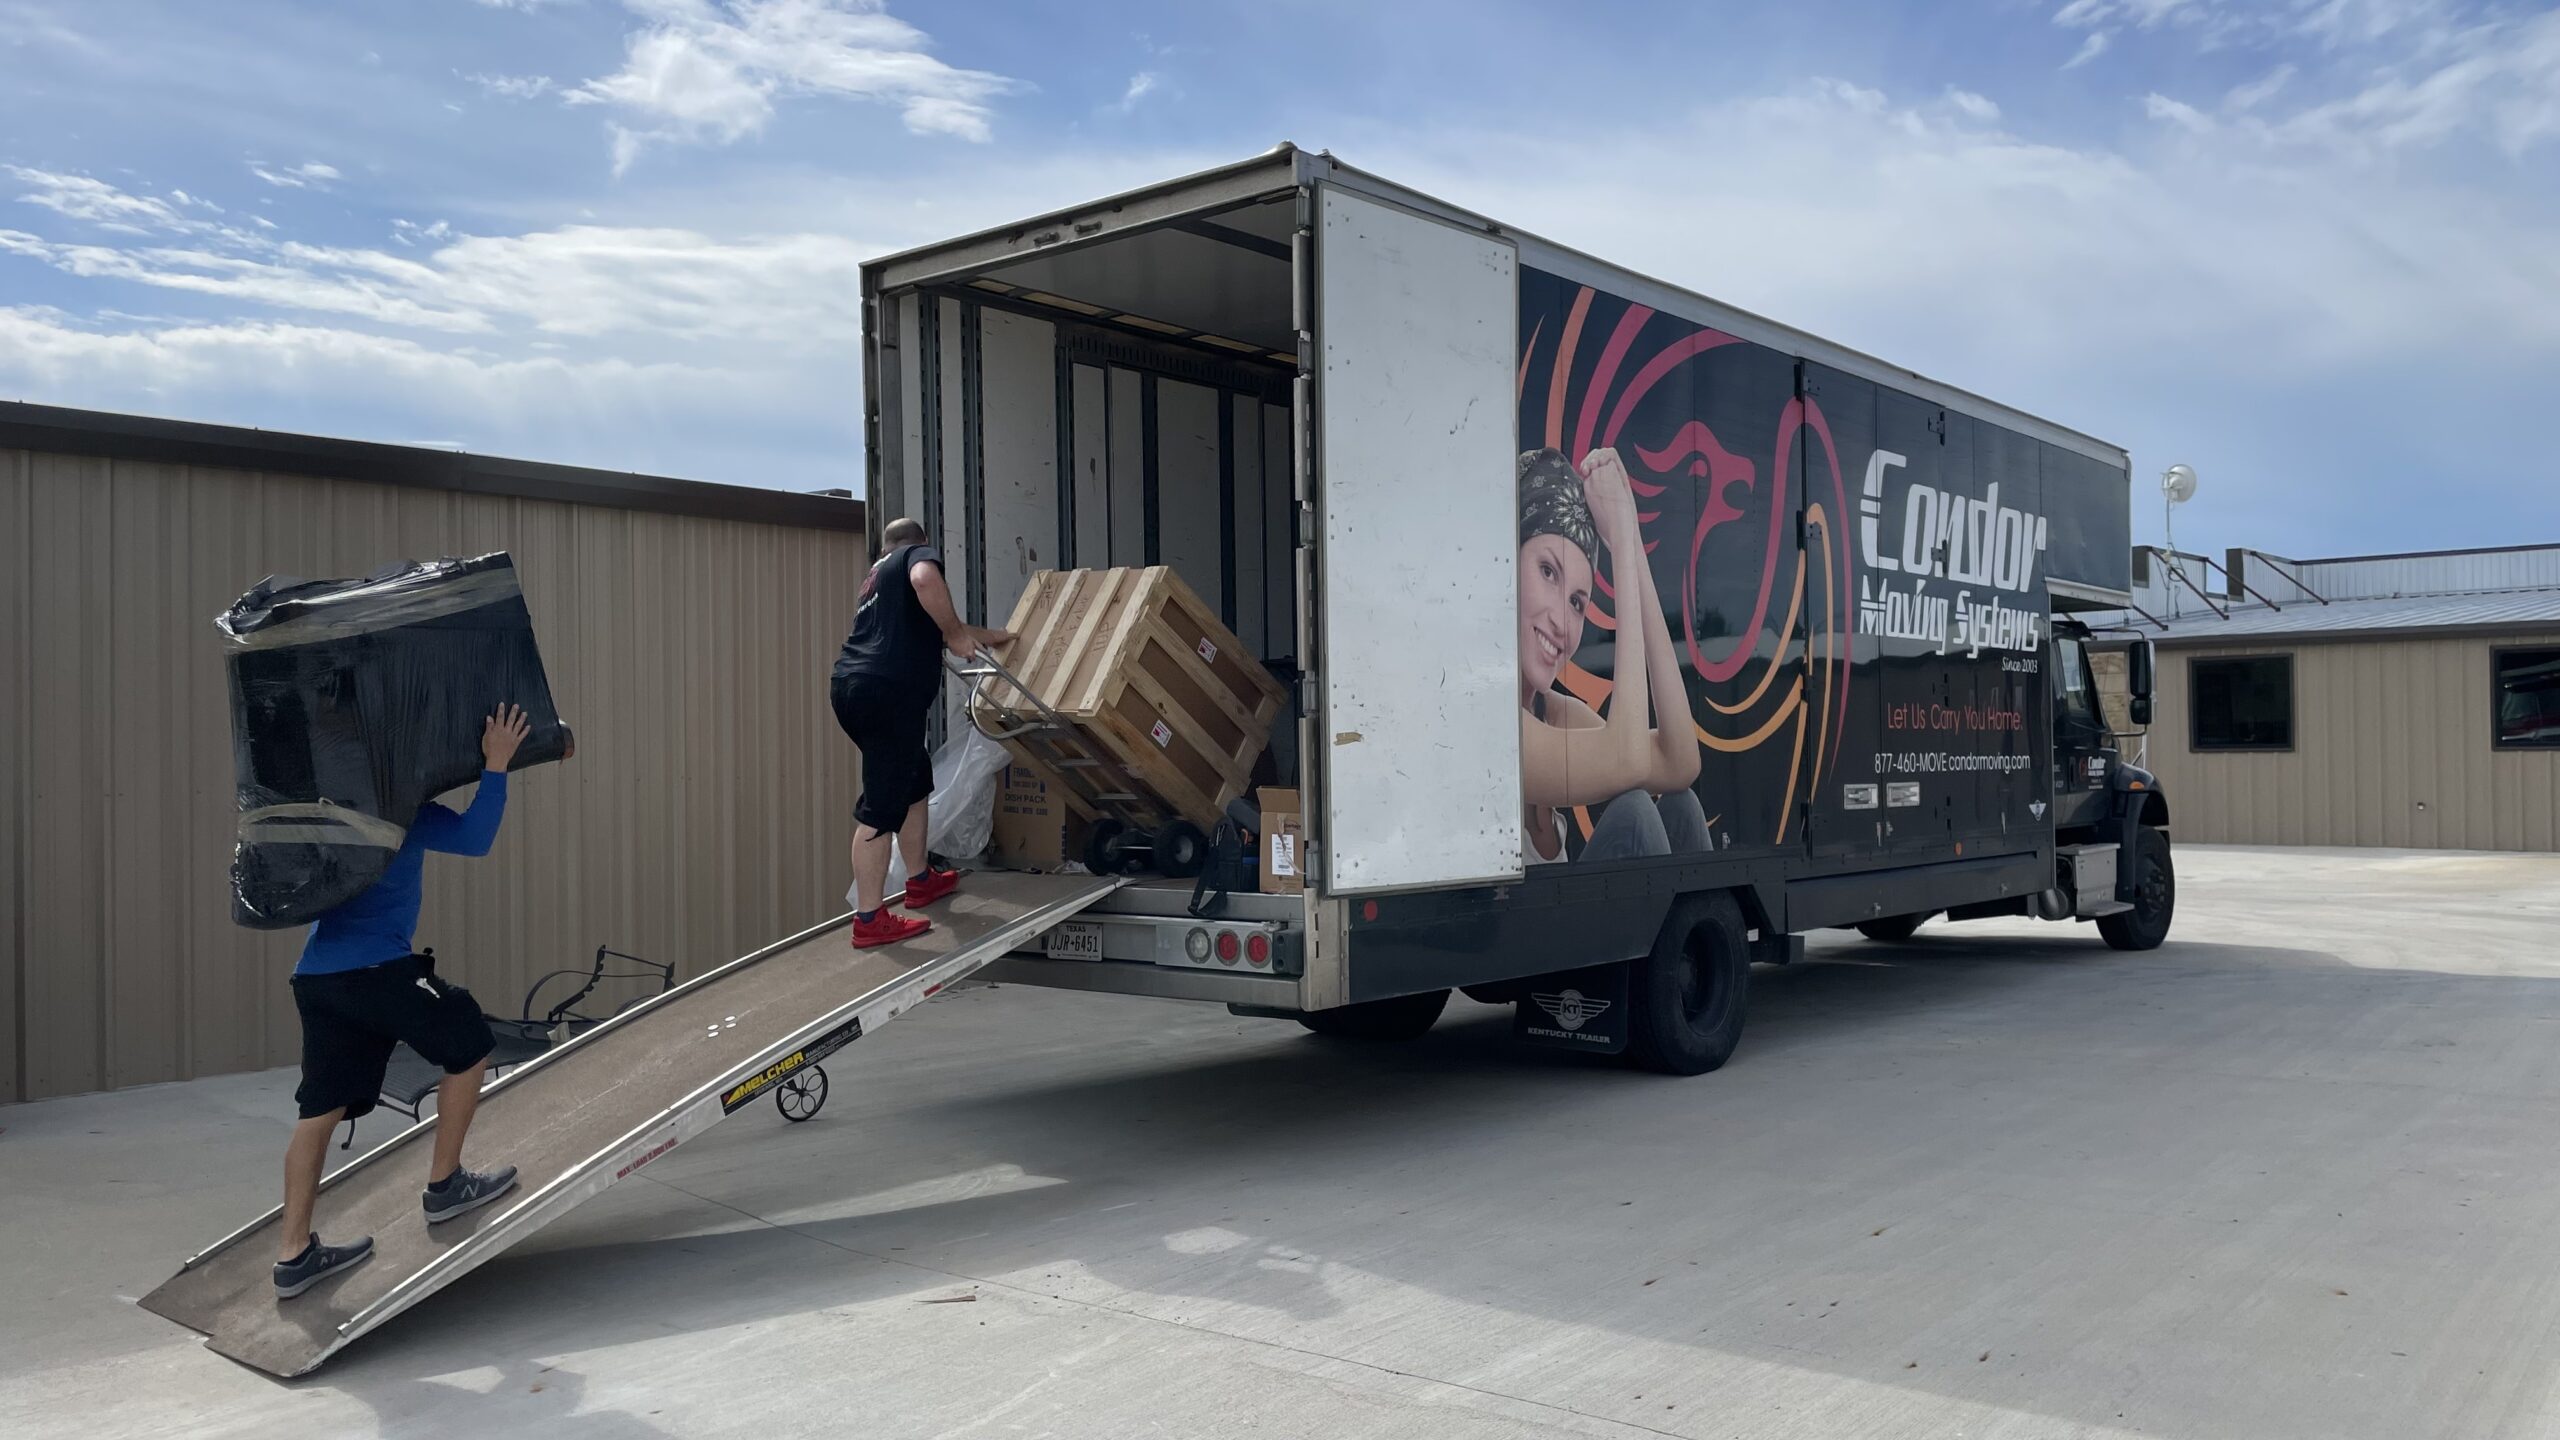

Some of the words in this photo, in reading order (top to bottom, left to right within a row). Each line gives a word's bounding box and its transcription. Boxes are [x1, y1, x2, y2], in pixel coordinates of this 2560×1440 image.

[1860, 449, 2047, 593] Condor
[1859, 574, 1949, 656] Moving
[1953, 590, 2040, 659] Systems
[2001, 656, 2021, 672] Since
[2021, 658, 2038, 673] 2003
[1887, 702, 1908, 729] Let
[1911, 703, 1926, 730] Us
[1930, 703, 1961, 736] Carry
[1964, 705, 1985, 731] You
[1988, 706, 2023, 731] Home.
[1874, 752, 1947, 774] 877-460-MOVE
[1948, 752, 2031, 775] condormoving.com
[1005, 792, 1022, 801] DISH
[1024, 794, 1046, 804] PACK
[1527, 1027, 1573, 1038] KENTUCKY
[1575, 1033, 1610, 1043] TRAILER
